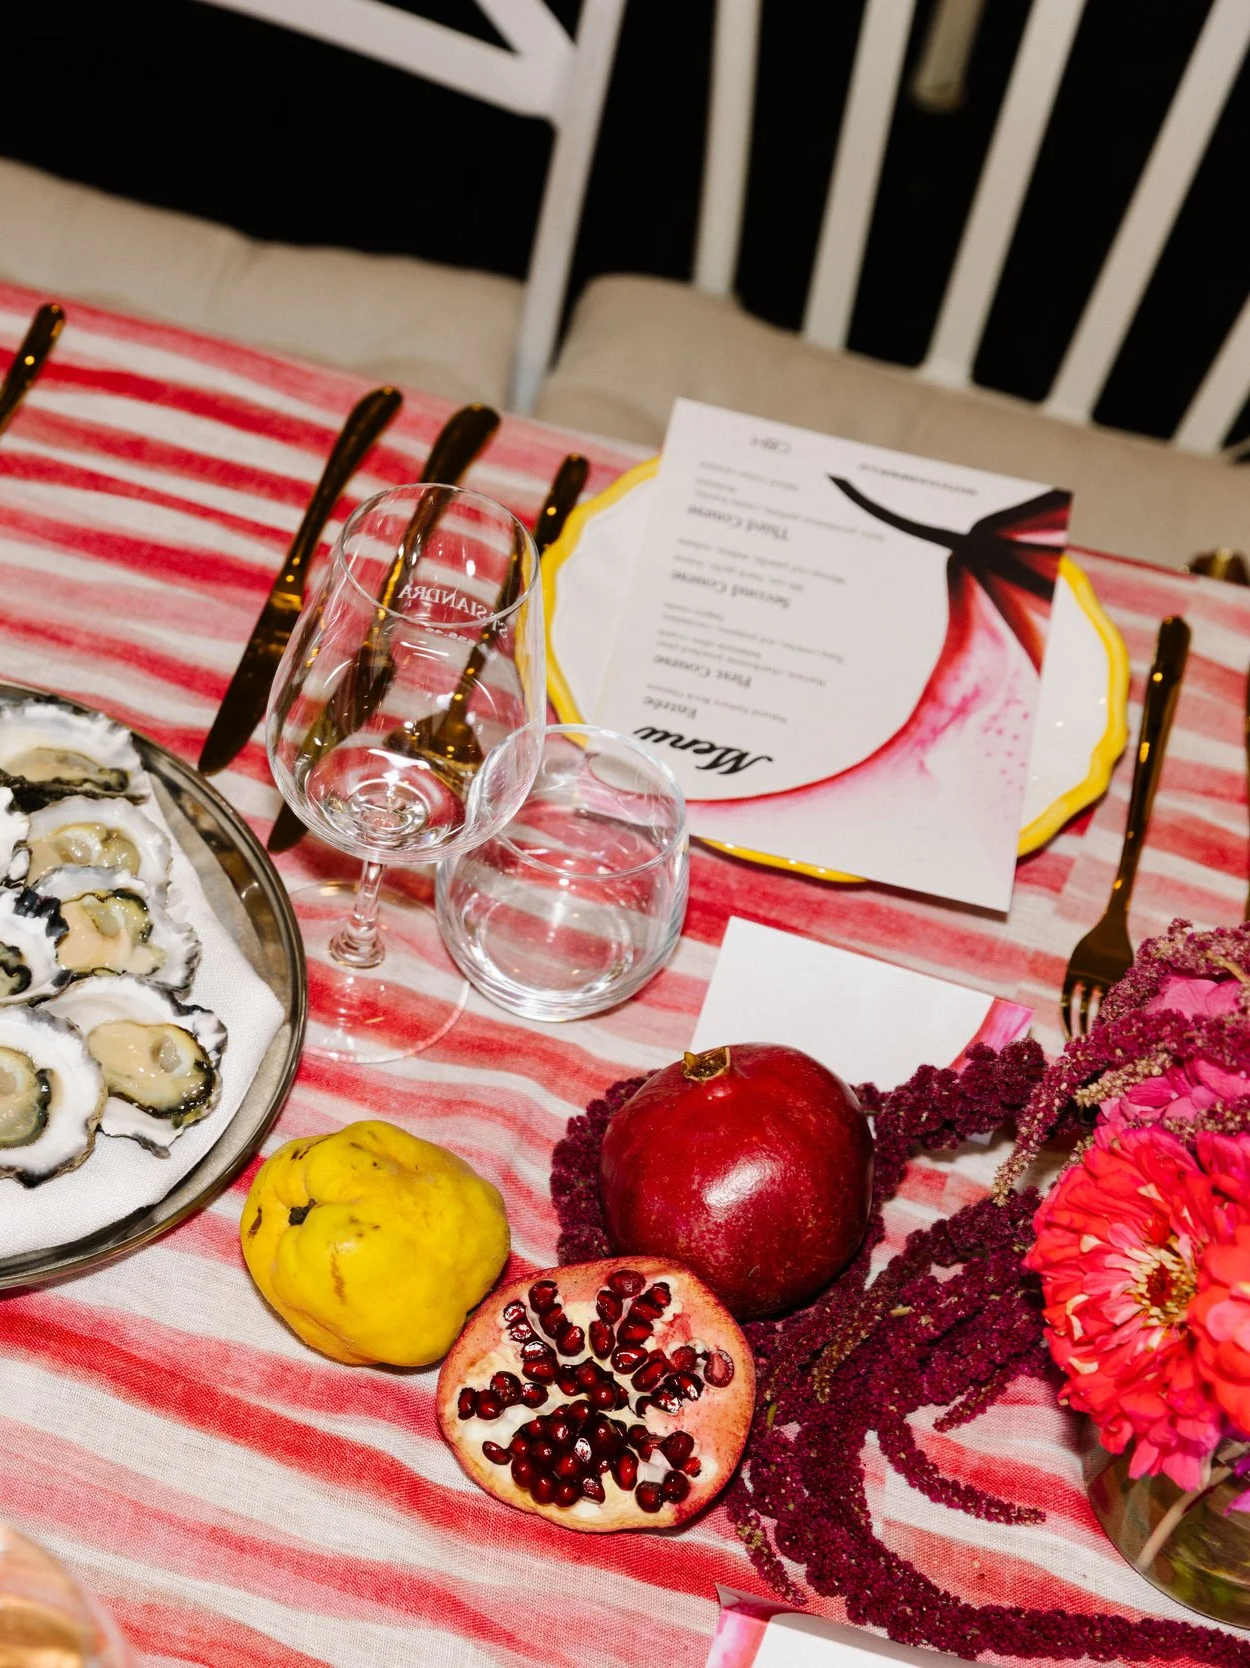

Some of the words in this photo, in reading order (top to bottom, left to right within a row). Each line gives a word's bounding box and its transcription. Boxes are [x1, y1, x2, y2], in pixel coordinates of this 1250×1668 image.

[686, 503, 743, 529] Course
[745, 518, 790, 541] Third
[669, 569, 728, 594] Course
[730, 583, 792, 610] Second
[652, 653, 712, 679] Course
[715, 668, 753, 689] First
[642, 695, 698, 720] Entrée
[633, 726, 773, 776] Menu
